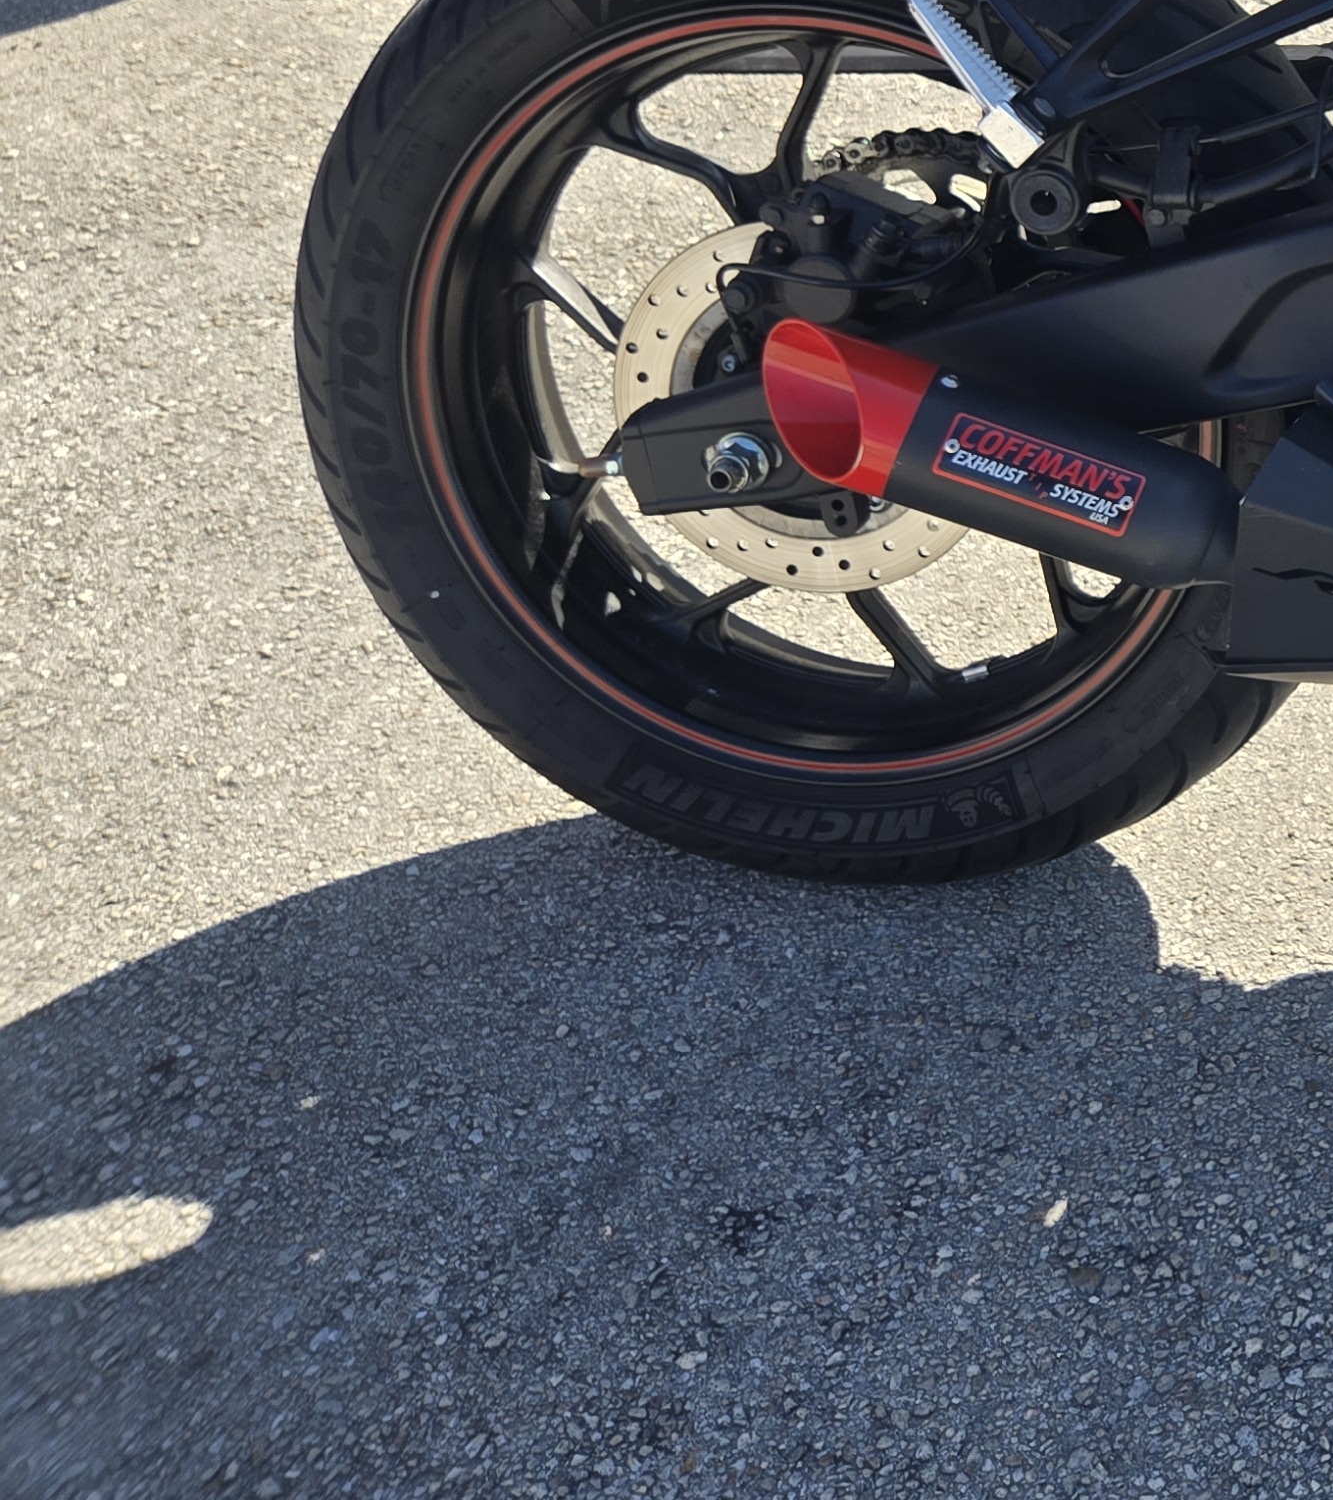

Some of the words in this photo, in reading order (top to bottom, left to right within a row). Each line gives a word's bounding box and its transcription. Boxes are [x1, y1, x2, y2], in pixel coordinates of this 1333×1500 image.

[951, 449, 1029, 485] EXHAUST
[1049, 483, 1122, 518] SYSTEMS
[959, 423, 1132, 499] COFFMAN'S
[1089, 512, 1110, 526] USA
[623, 763, 936, 843] MICHELIN
